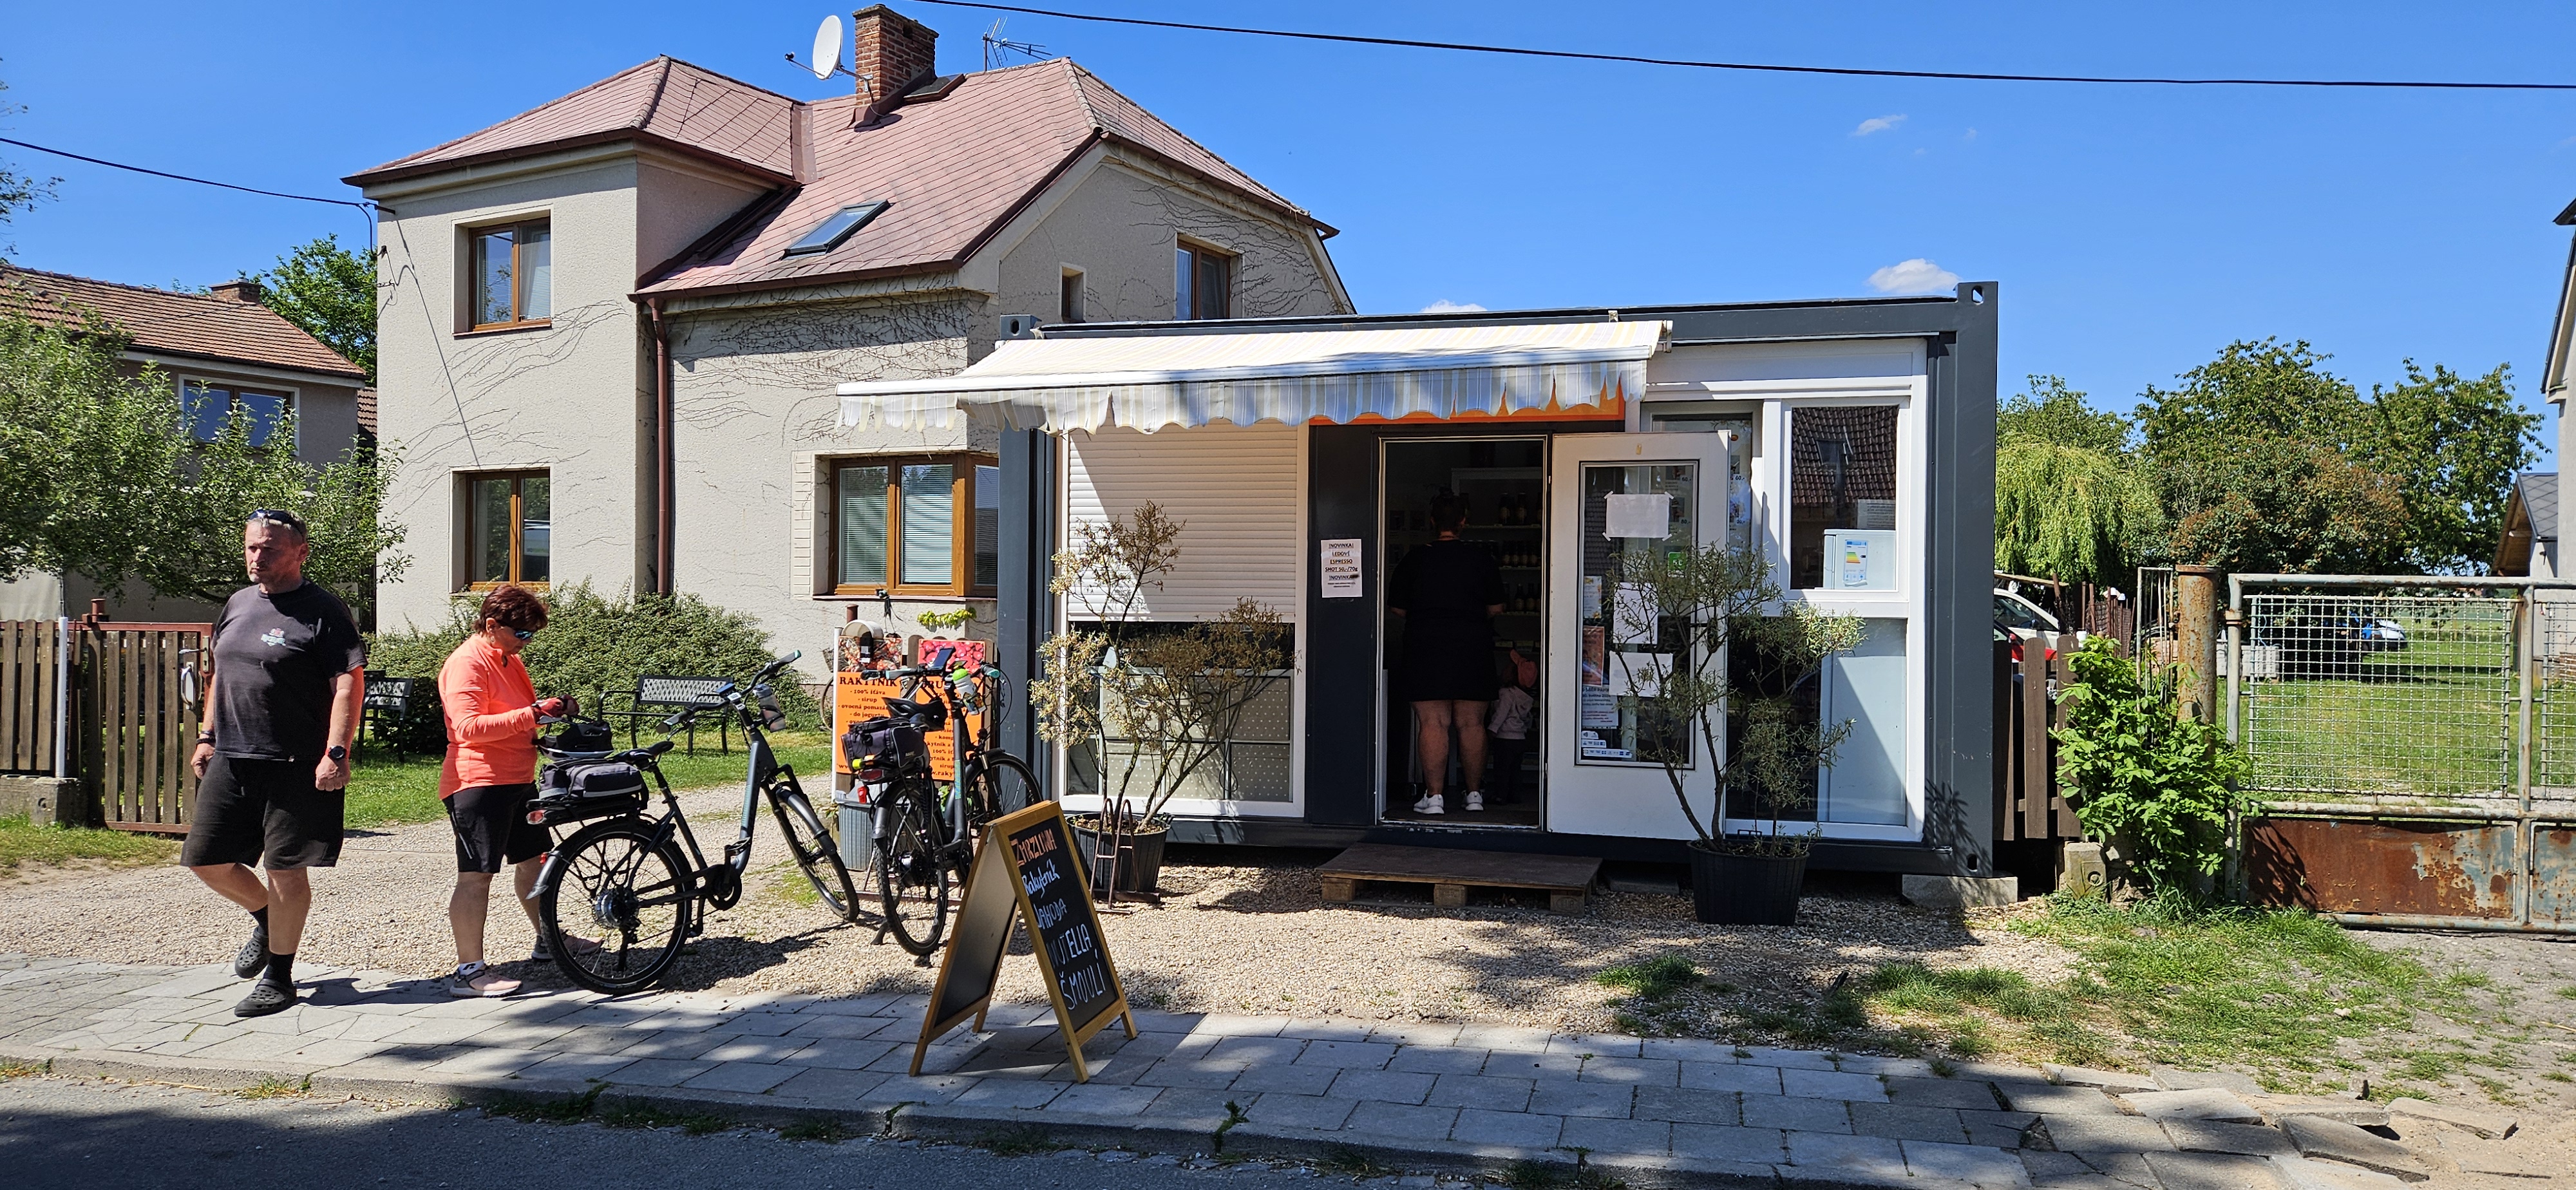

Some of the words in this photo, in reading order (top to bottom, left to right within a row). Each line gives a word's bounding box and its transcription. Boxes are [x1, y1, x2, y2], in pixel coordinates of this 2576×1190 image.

[1010, 828, 1057, 867] ZMRZLINA
[1033, 898, 1068, 929] JAHODA
[1046, 923, 1092, 968] NUTELLA
